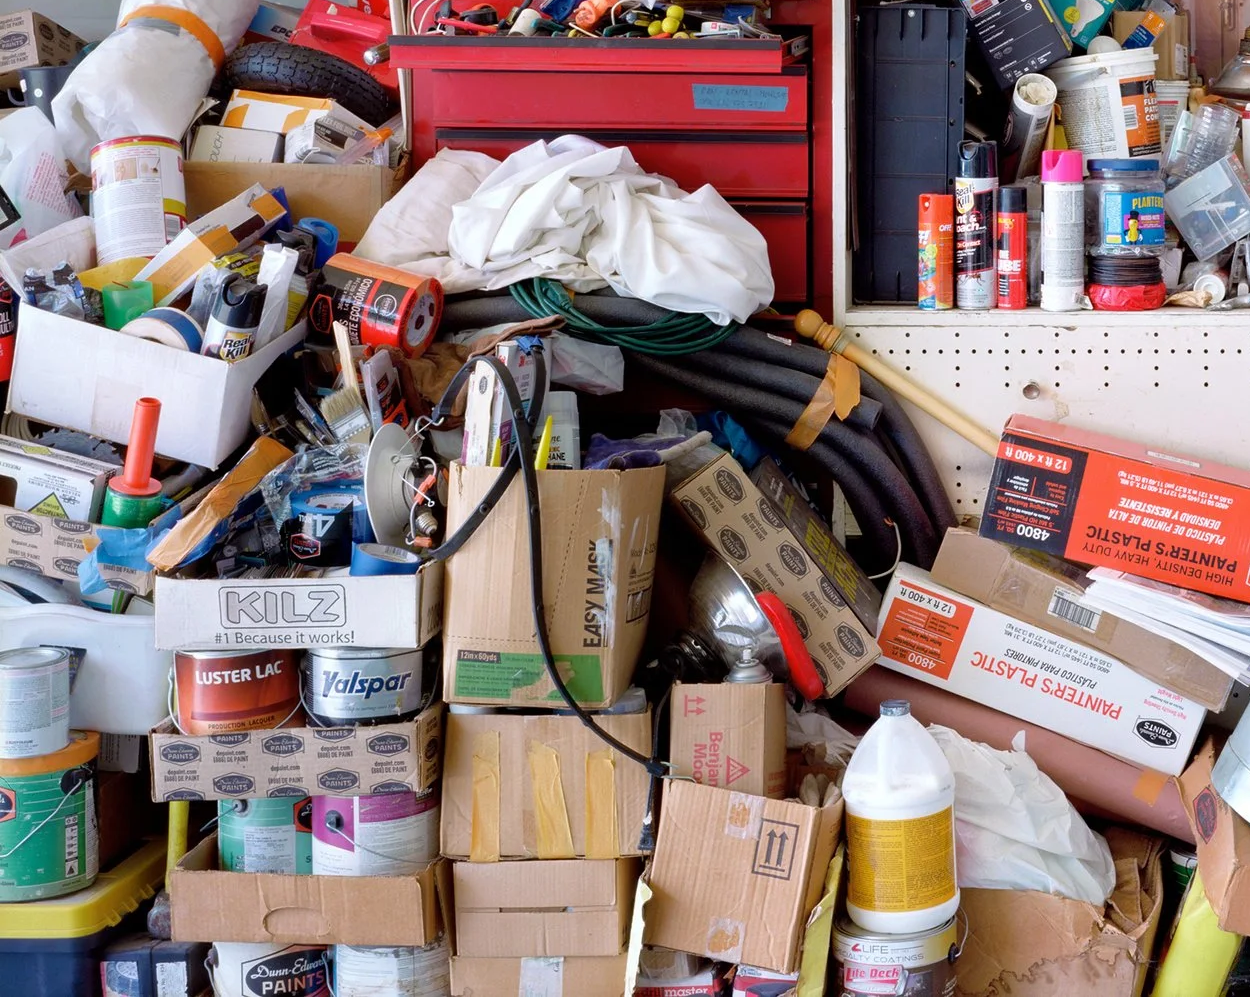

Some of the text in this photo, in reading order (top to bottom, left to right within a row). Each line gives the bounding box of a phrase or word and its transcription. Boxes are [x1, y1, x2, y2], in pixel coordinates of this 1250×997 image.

[939, 224, 952, 232] OFF!
[226, 347, 247, 359] Kill
[1005, 446, 1068, 471] 12 ft x 400 ft
[718, 476, 737, 499] PAINTS
[760, 503, 780, 526] PAINTS
[997, 509, 1010, 517] Film
[1010, 512, 1028, 521] Plastic
[1118, 497, 1222, 531] DENSIDAD Y RESISTENTE
[11, 522, 36, 533] PAINTS
[59, 521, 85, 531] PAINTS
[311, 516, 335, 537] 4
[1016, 523, 1051, 542] 4800
[1107, 508, 1226, 547] PLÁSTICO DE PINTOR DE ALTA
[721, 535, 741, 558] PAINTS
[1085, 525, 1238, 573] PAINTER'S PLASTIC
[781, 551, 800, 573] PAINTS
[1082, 542, 1234, 586] HIGH DENSITY, HEAVY DUTY
[583, 539, 606, 648] EASY MASK
[821, 582, 841, 605] PAINTS
[899, 587, 908, 597] ft
[907, 590, 926, 604] 400
[226, 591, 340, 624] KILZ
[932, 600, 940, 609] ft
[941, 603, 953, 614] 12
[215, 631, 355, 644] #1 Because it works!
[838, 632, 858, 655] PAINTS
[907, 652, 937, 671] 4800
[969, 650, 1039, 688] PLASTIC
[1003, 648, 1098, 691] PLÁSTICO PARA PINTORES
[195, 661, 282, 685] LUSTER LAC
[322, 670, 412, 699] Valspar
[1039, 677, 1123, 721] PAINTER'S
[208, 715, 275, 730] PRODUCTION LACQUER
[1143, 721, 1173, 738] PAINTS
[216, 734, 243, 742] PAINTS
[321, 729, 348, 737] PAINTS
[167, 752, 194, 760] PAINTS
[270, 744, 296, 752] PAINTS
[375, 744, 402, 752] PAINTS
[693, 743, 707, 783] Moo
[708, 732, 723, 787] Benjam
[862, 944, 889, 954] LIFE
[250, 957, 328, 979] Dunn-Edwar
[873, 954, 924, 964] COATINGS
[262, 971, 325, 995] PAINTS
[846, 968, 900, 982] Life Deck
[664, 987, 709, 997] master
